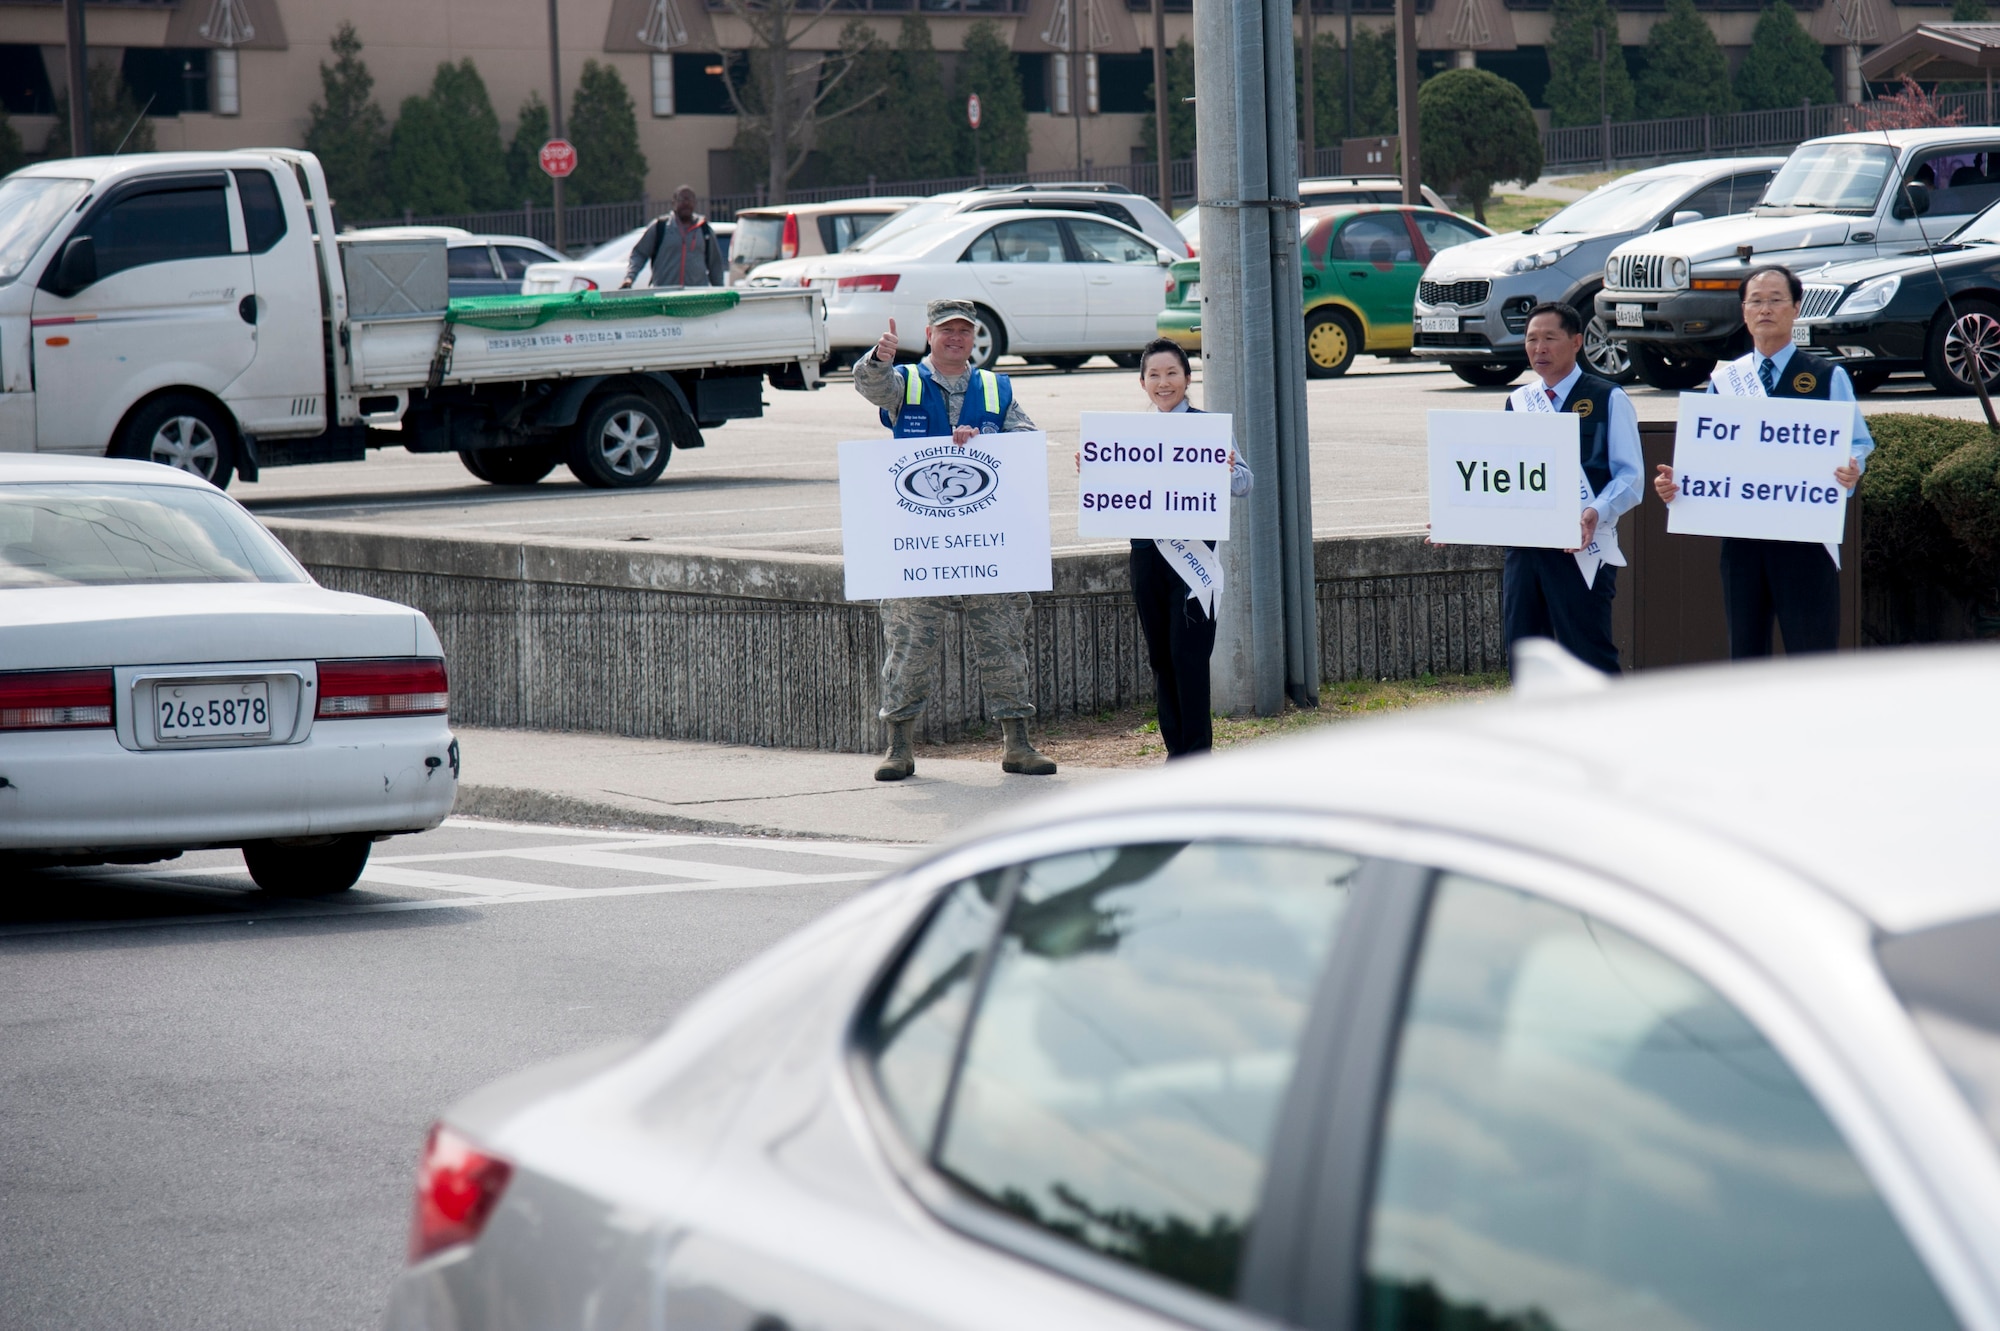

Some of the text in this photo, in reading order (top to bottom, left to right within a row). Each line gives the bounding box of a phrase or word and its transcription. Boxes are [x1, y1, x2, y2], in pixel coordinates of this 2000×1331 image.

[543, 146, 571, 160] STOP
[1726, 364, 1746, 397] FRIEND
[1696, 416, 1840, 446] For better
[914, 445, 966, 460] FIGHTER
[969, 448, 1002, 469] WING
[1083, 441, 1226, 464] School zone
[1455, 460, 1546, 493] Yield
[1083, 490, 1217, 512] speed limit
[1681, 475, 1839, 504] taxi service
[896, 494, 998, 518] MUSTANG SAFETY
[893, 532, 1005, 551] DRIVE SAFELY!
[903, 564, 998, 581] NO TEXTING
[1183, 552, 1212, 588] PRIDE!
[161, 697, 267, 729] 26오5878
